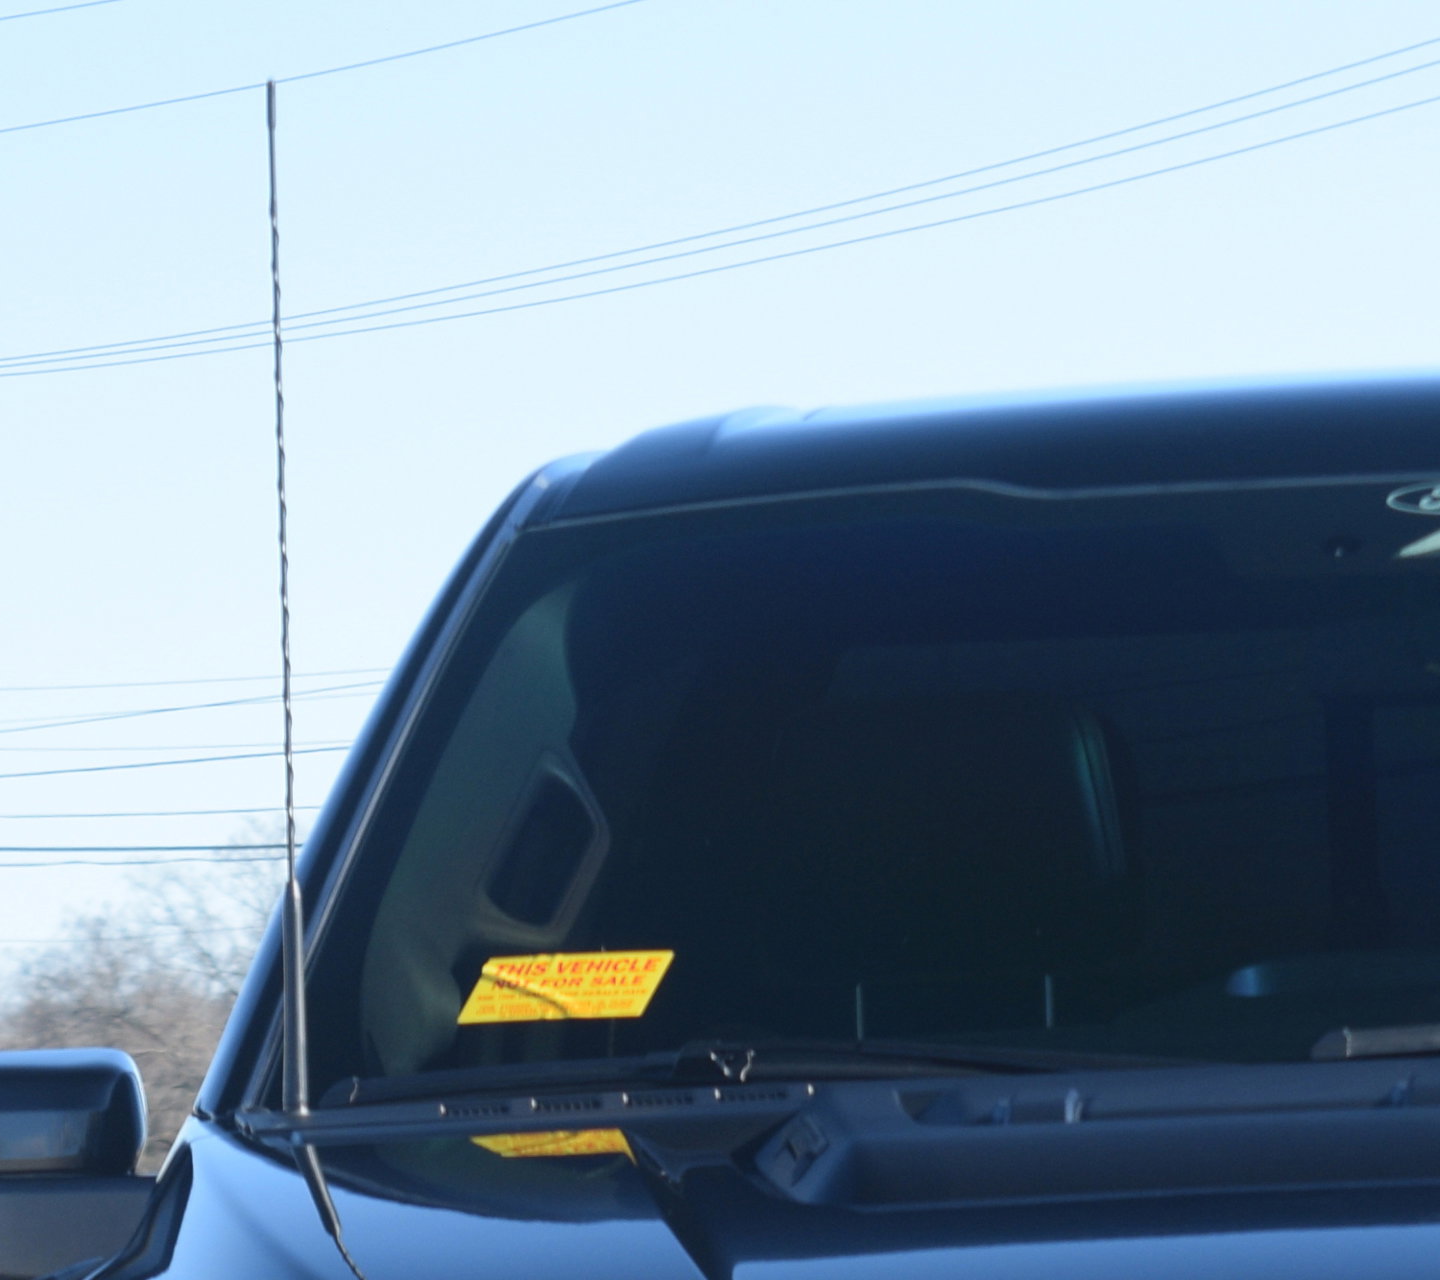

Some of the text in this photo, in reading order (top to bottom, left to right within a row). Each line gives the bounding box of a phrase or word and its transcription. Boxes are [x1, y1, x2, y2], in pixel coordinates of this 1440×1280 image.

[496, 957, 662, 977] THIS VEHICLE
[540, 976, 583, 988] FOR
[591, 975, 647, 987] SALE
